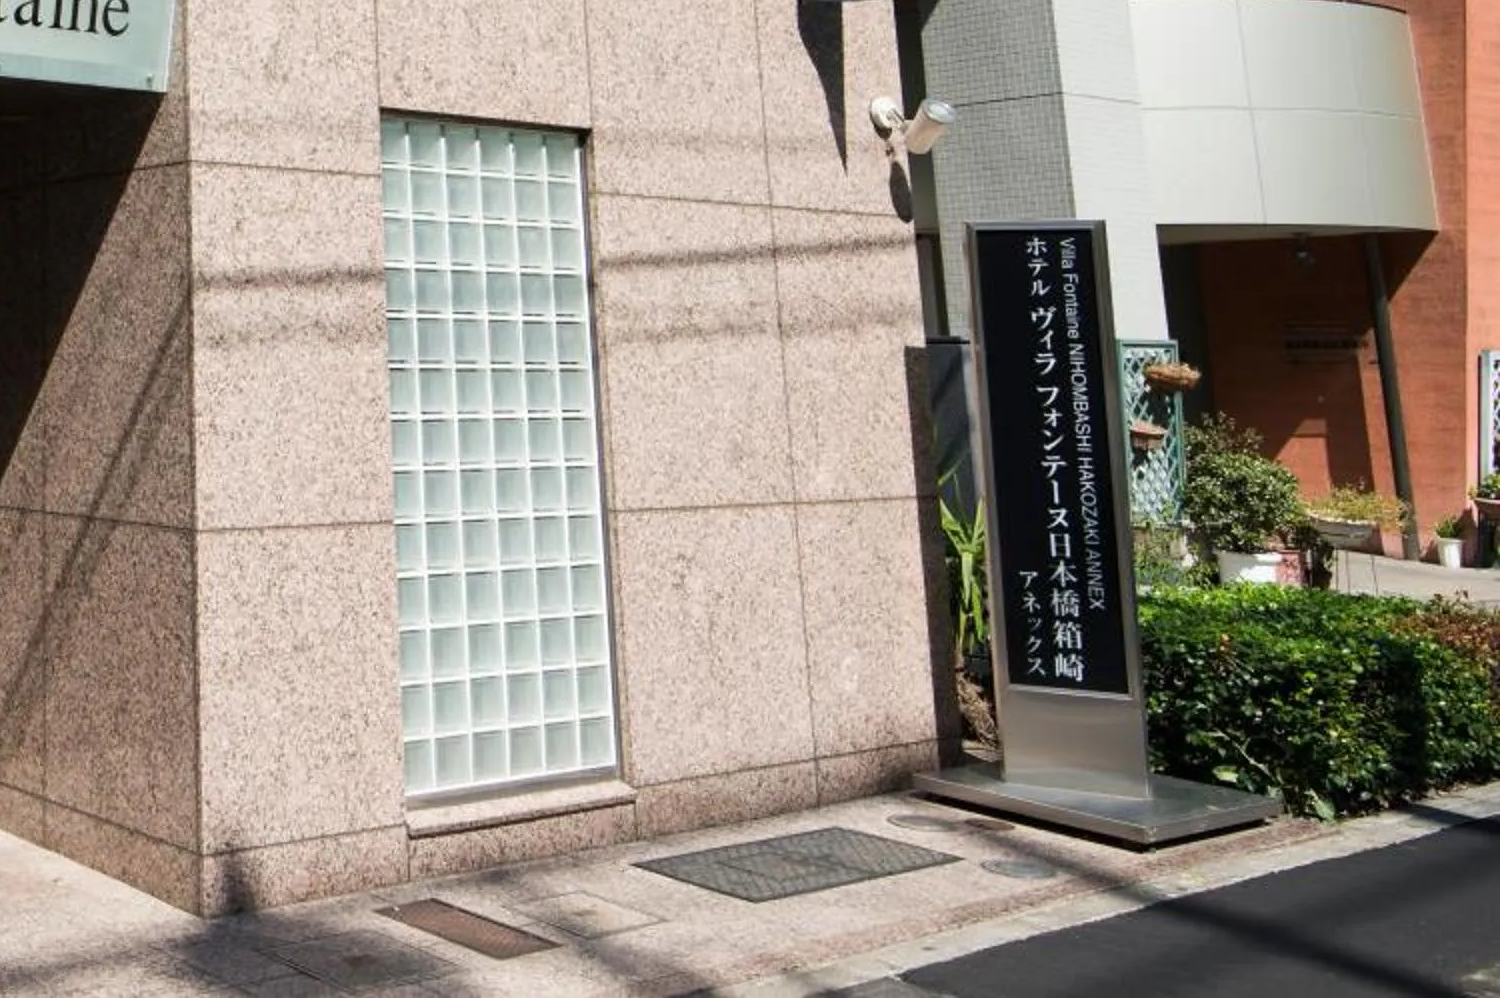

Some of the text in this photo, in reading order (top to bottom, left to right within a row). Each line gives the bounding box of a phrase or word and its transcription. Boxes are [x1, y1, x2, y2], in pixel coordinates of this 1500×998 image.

[1026, 237, 1051, 296] ホテル
[1060, 237, 1106, 610] Villa Fontaine NIHOMBASHI HAKOZAKI ANNEX
[1019, 570, 1046, 677] アネックス
